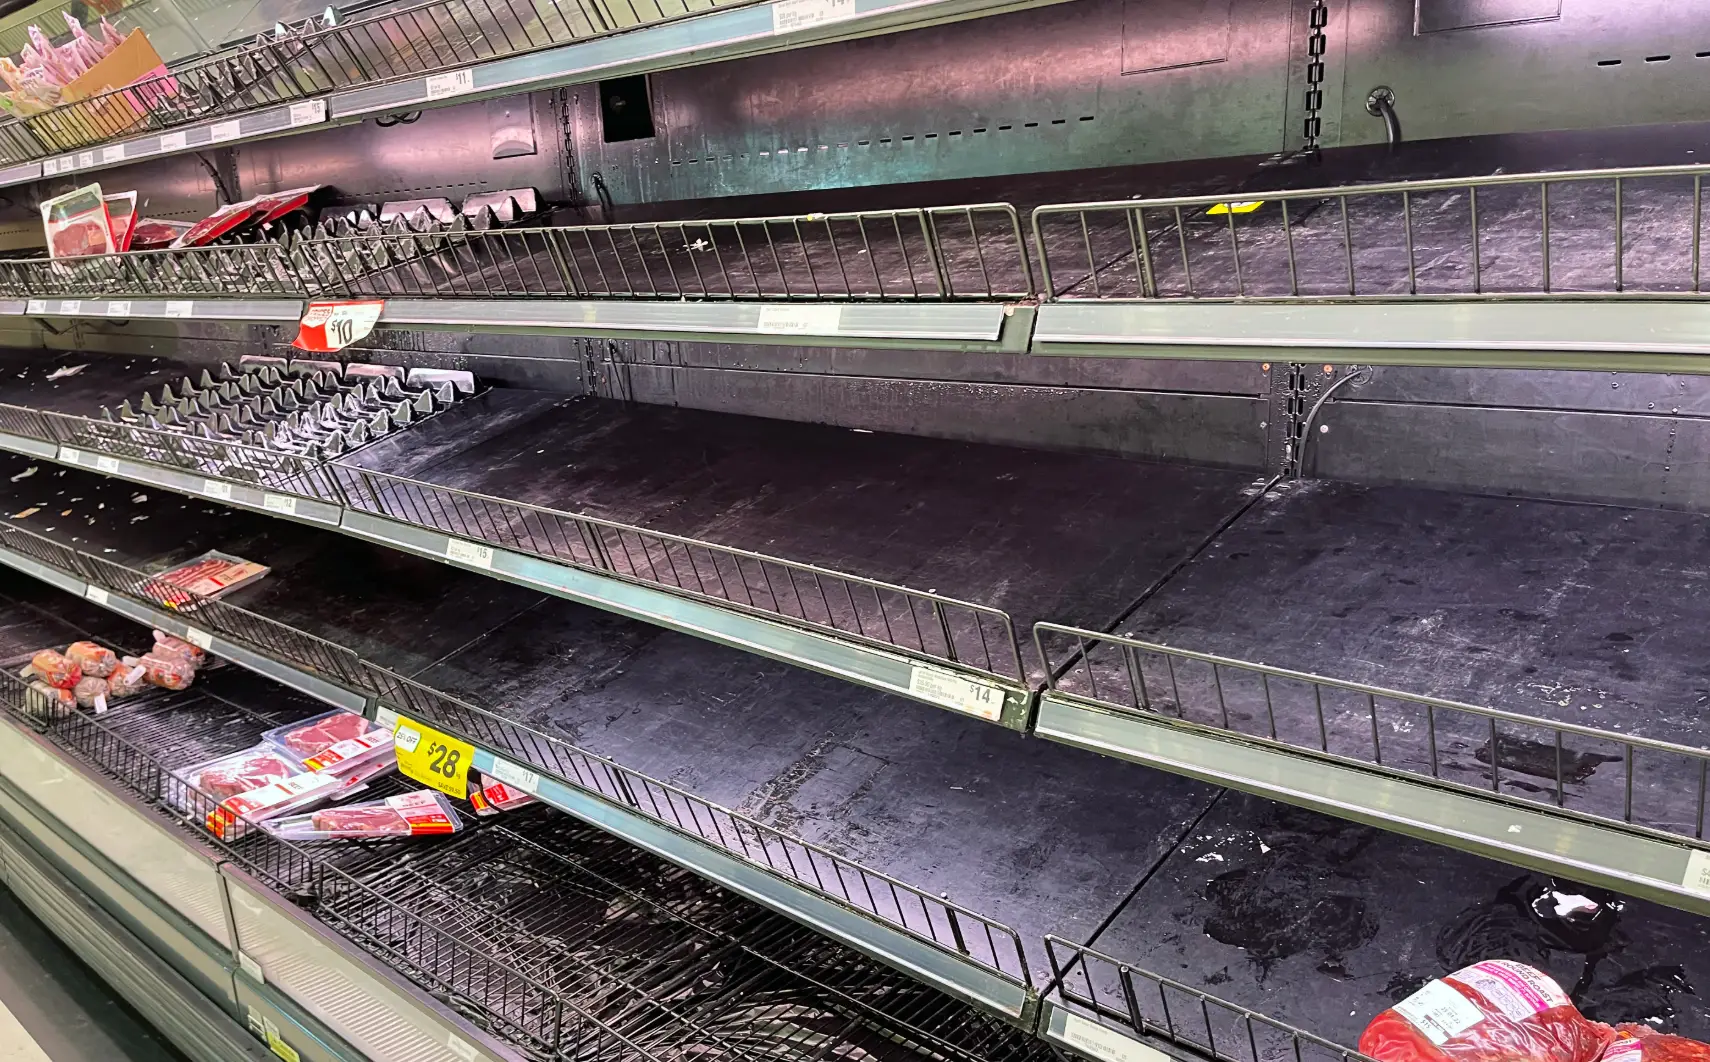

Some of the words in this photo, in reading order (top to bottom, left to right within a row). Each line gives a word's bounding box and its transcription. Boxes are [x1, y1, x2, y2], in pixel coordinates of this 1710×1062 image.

[331, 318, 353, 345] $10
[969, 684, 991, 704] $14
[427, 740, 461, 779] $28
[1515, 963, 1542, 981] BEEF
[1528, 980, 1554, 1003] ROAST
